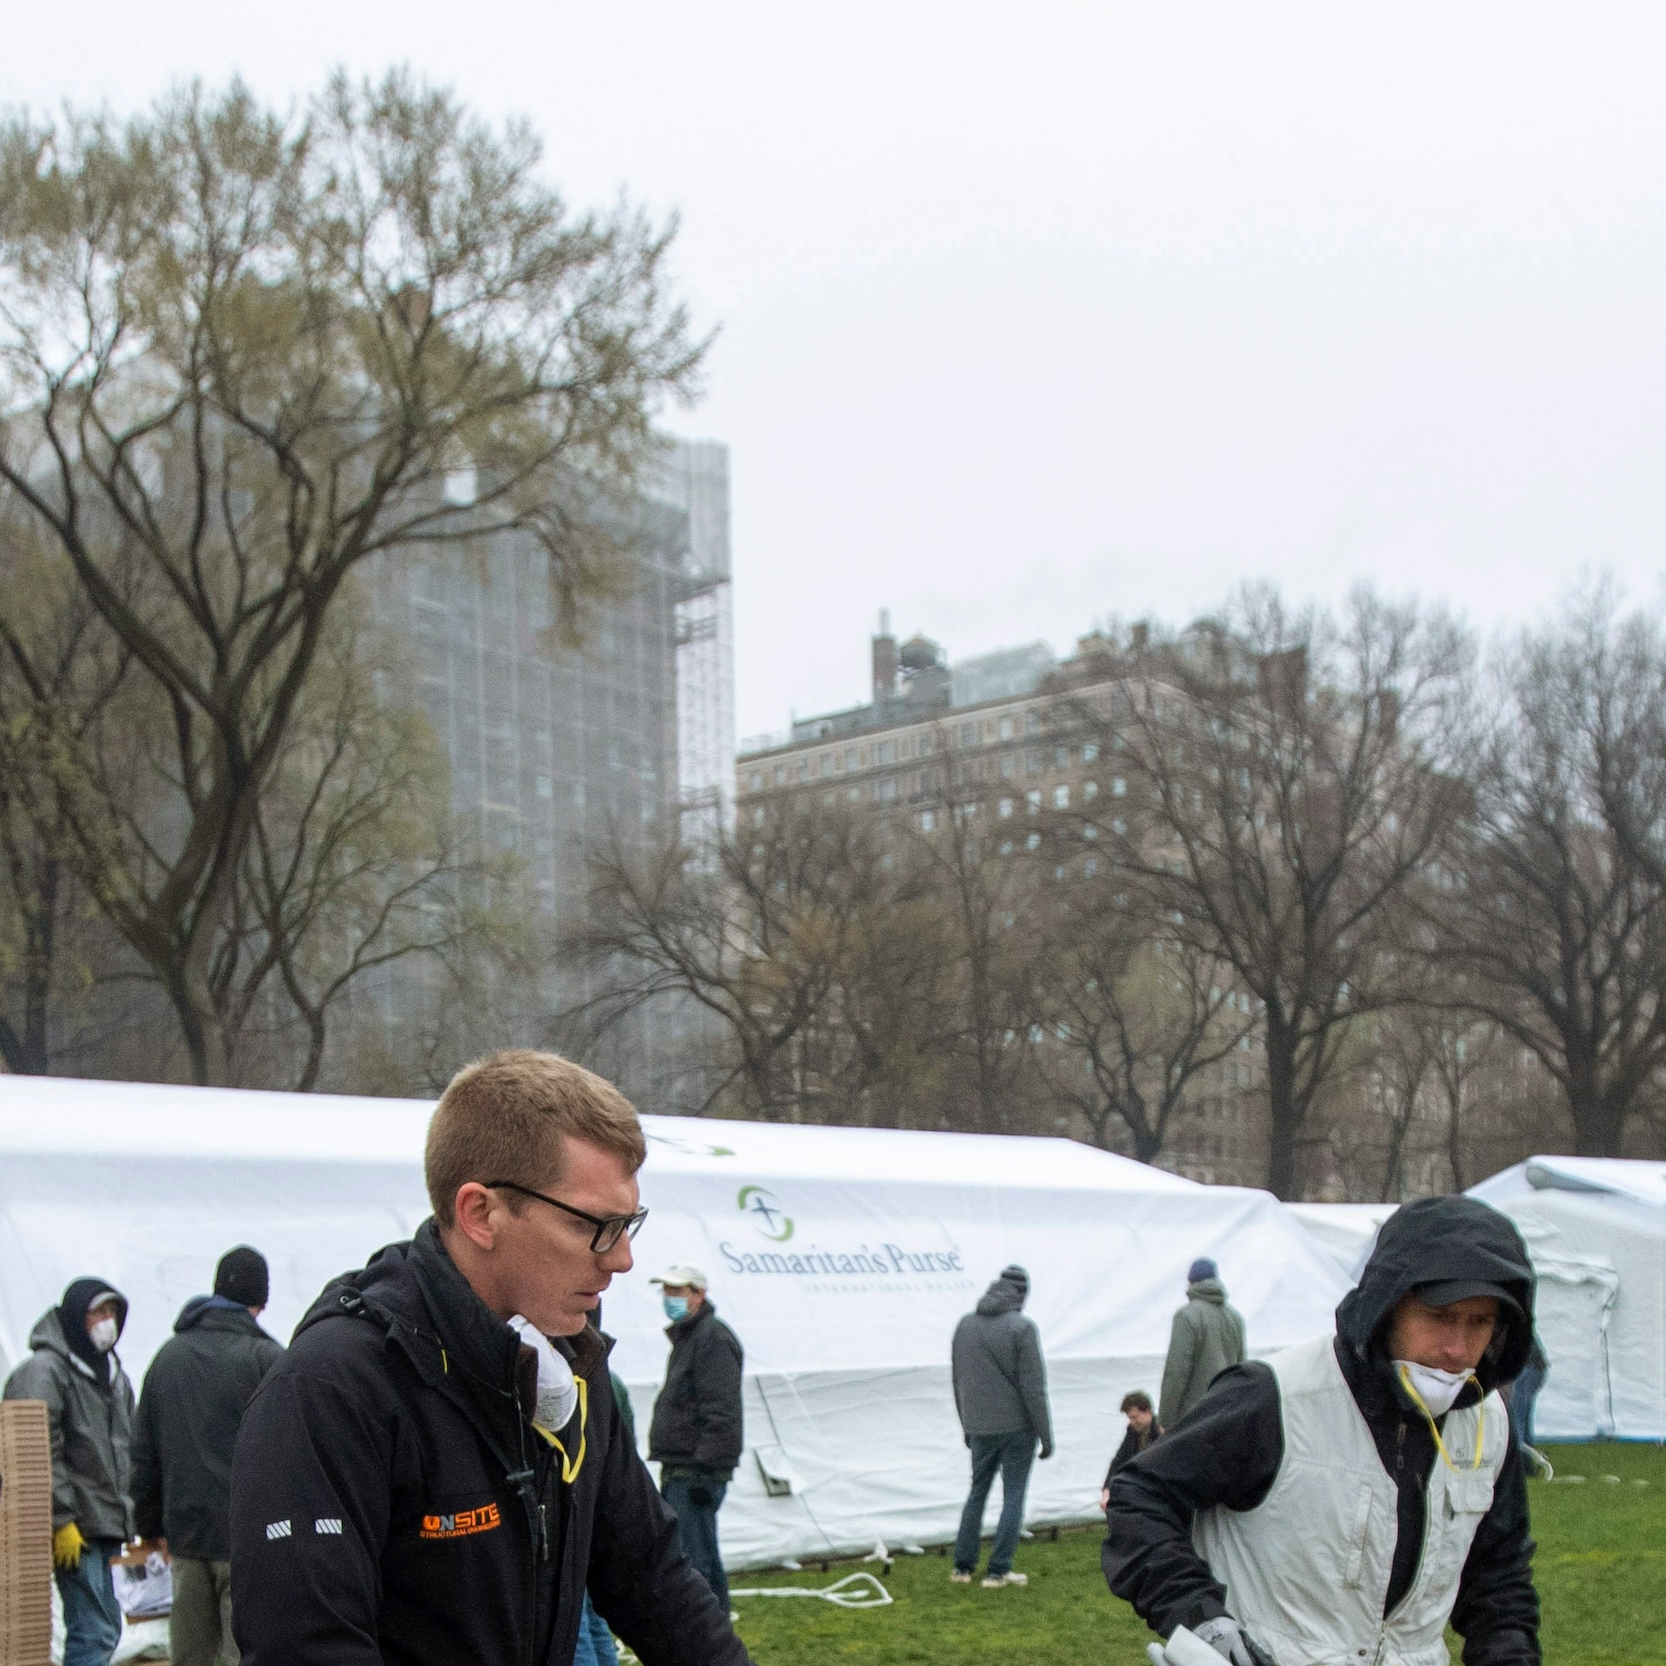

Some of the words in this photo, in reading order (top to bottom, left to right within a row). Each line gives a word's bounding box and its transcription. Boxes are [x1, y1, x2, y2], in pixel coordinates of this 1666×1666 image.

[719, 1241, 889, 1274] Samaritan's
[883, 1243, 964, 1273] Purse
[422, 1502, 500, 1530] ONSITE
